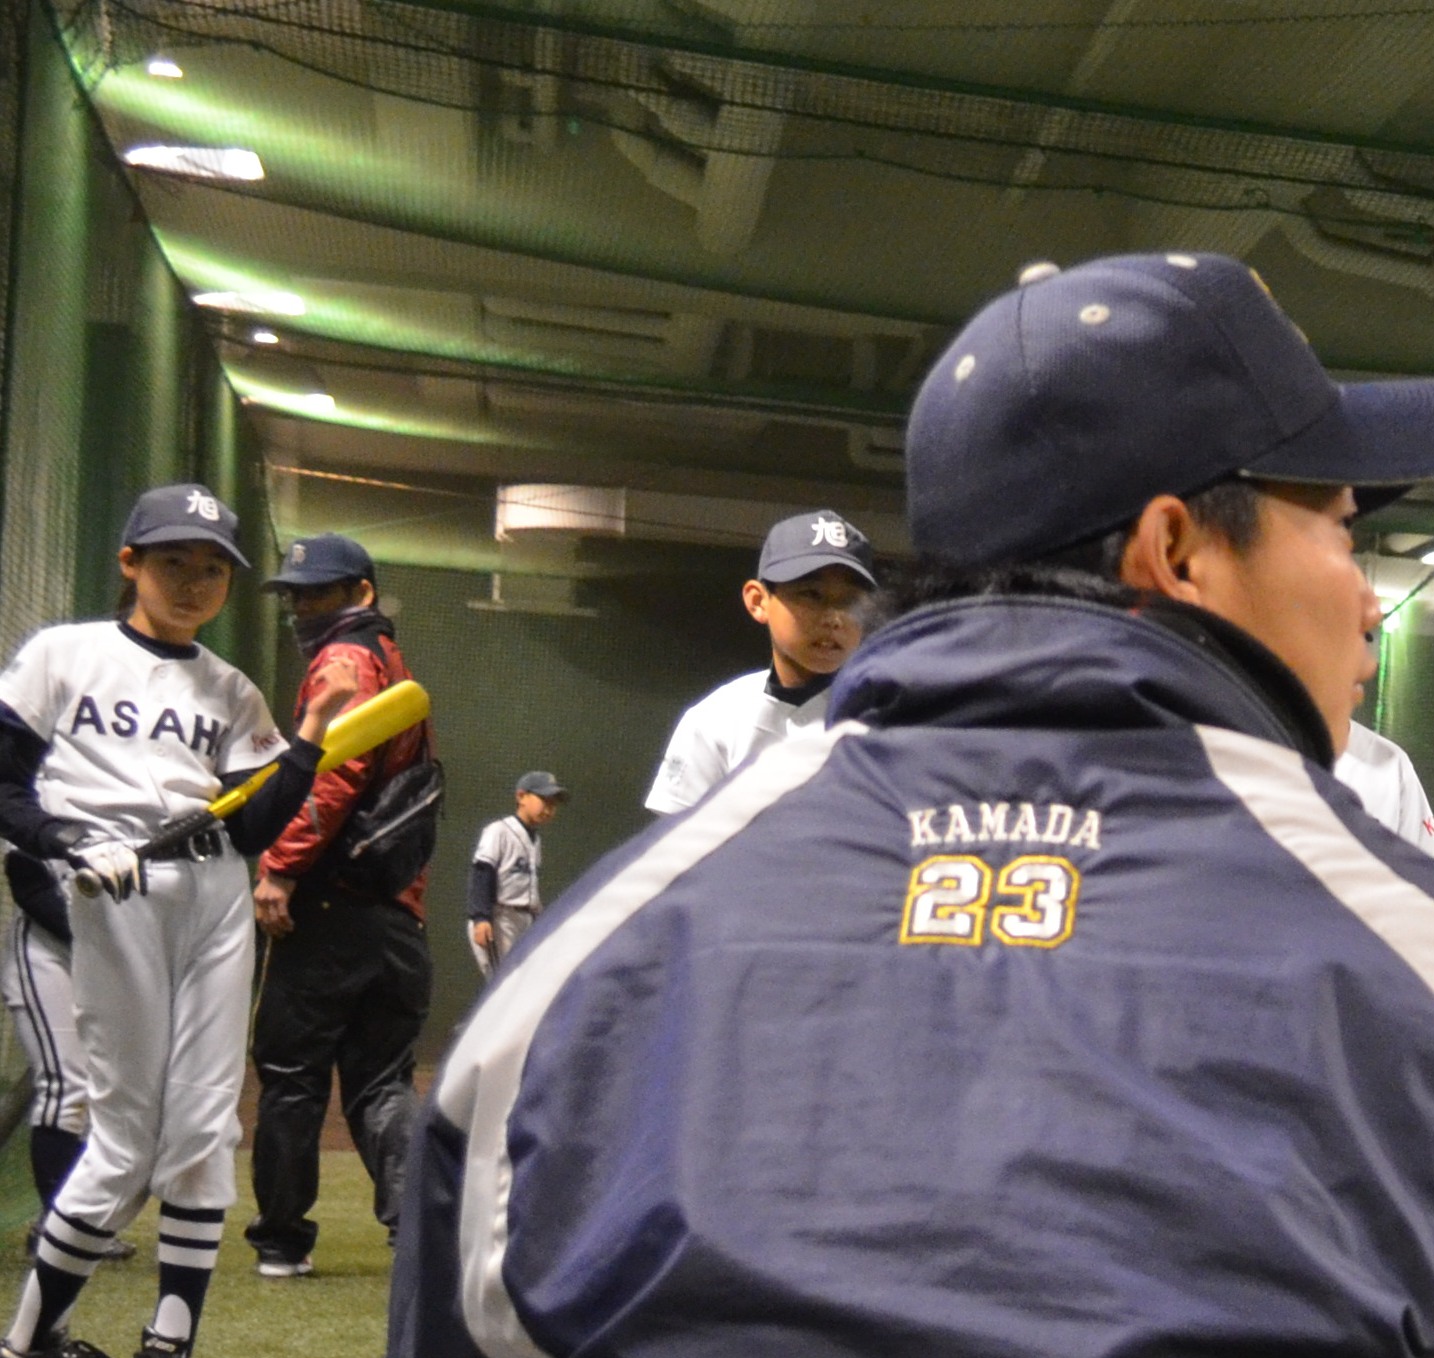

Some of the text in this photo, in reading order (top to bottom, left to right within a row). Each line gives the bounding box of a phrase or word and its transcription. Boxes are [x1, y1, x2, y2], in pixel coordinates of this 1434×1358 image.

[186, 489, 220, 521] 旭
[811, 517, 849, 548] 旭
[907, 802, 1101, 850] KAMADA
[899, 854, 1082, 948] 23
